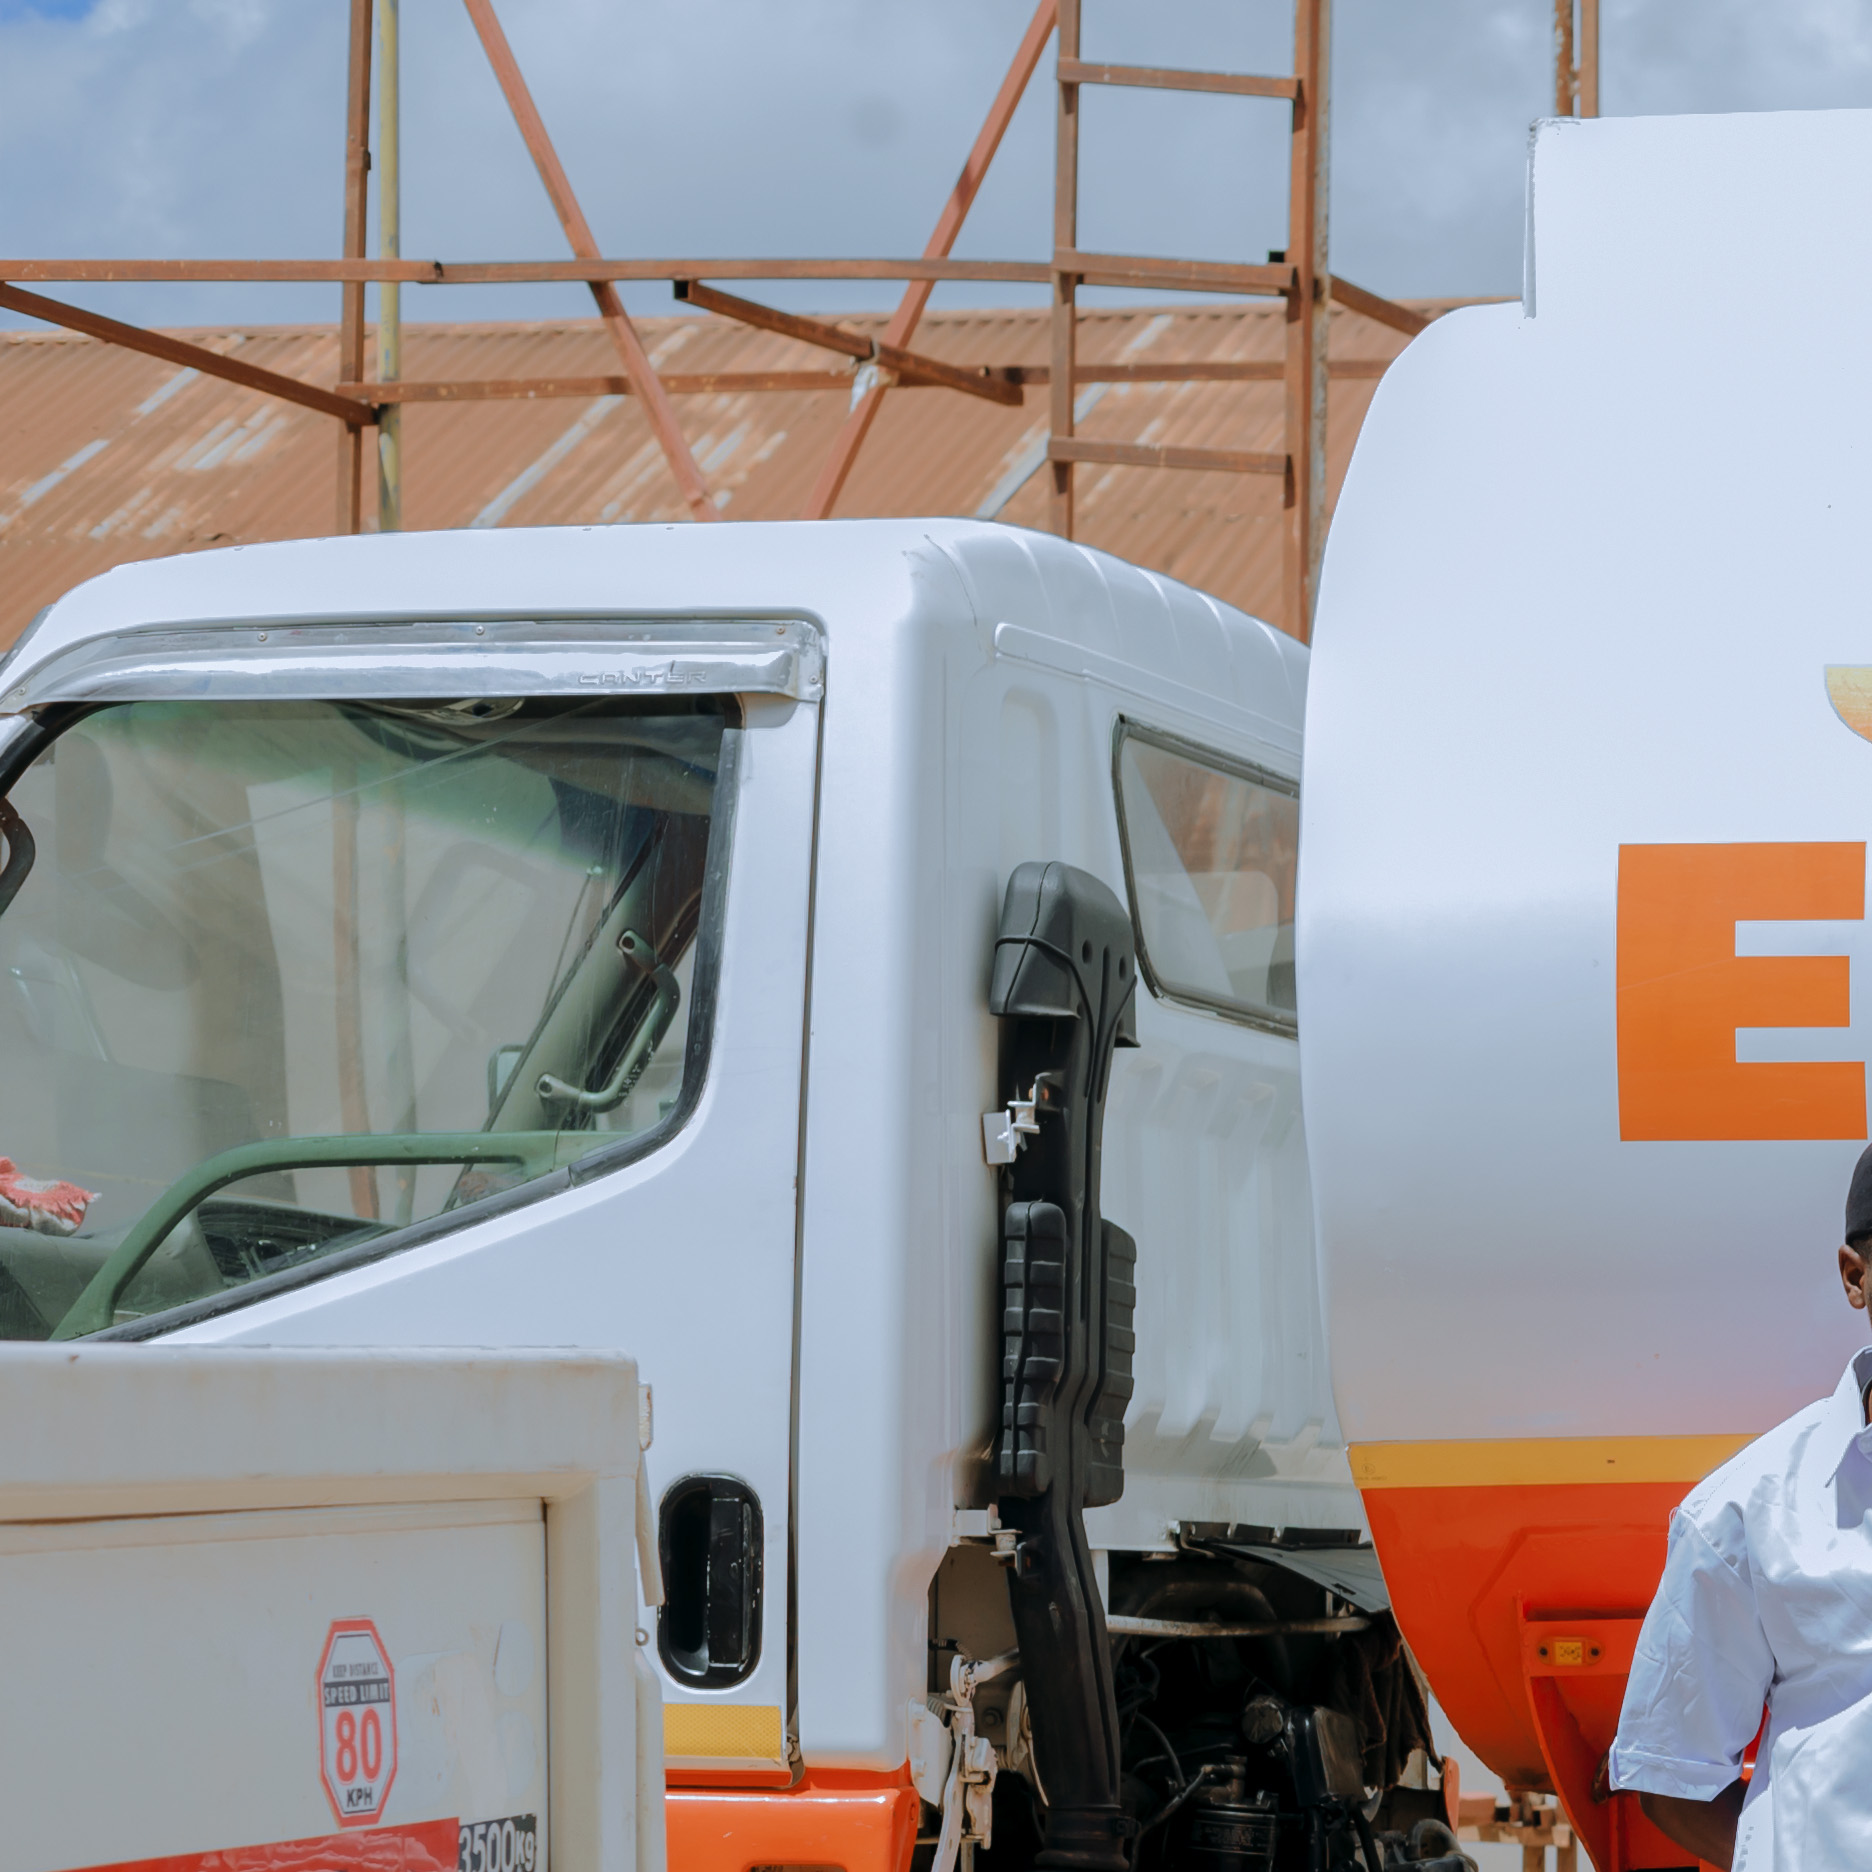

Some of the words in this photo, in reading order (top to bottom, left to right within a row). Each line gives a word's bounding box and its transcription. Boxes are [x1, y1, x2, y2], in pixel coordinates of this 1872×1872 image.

[332, 1664, 347, 1679] KEEP
[349, 1661, 379, 1677] DISTANCE
[324, 1685, 358, 1704] SPEED
[360, 1682, 390, 1701] LIMIT
[335, 1706, 382, 1786] 80
[346, 1787, 373, 1808] KPH
